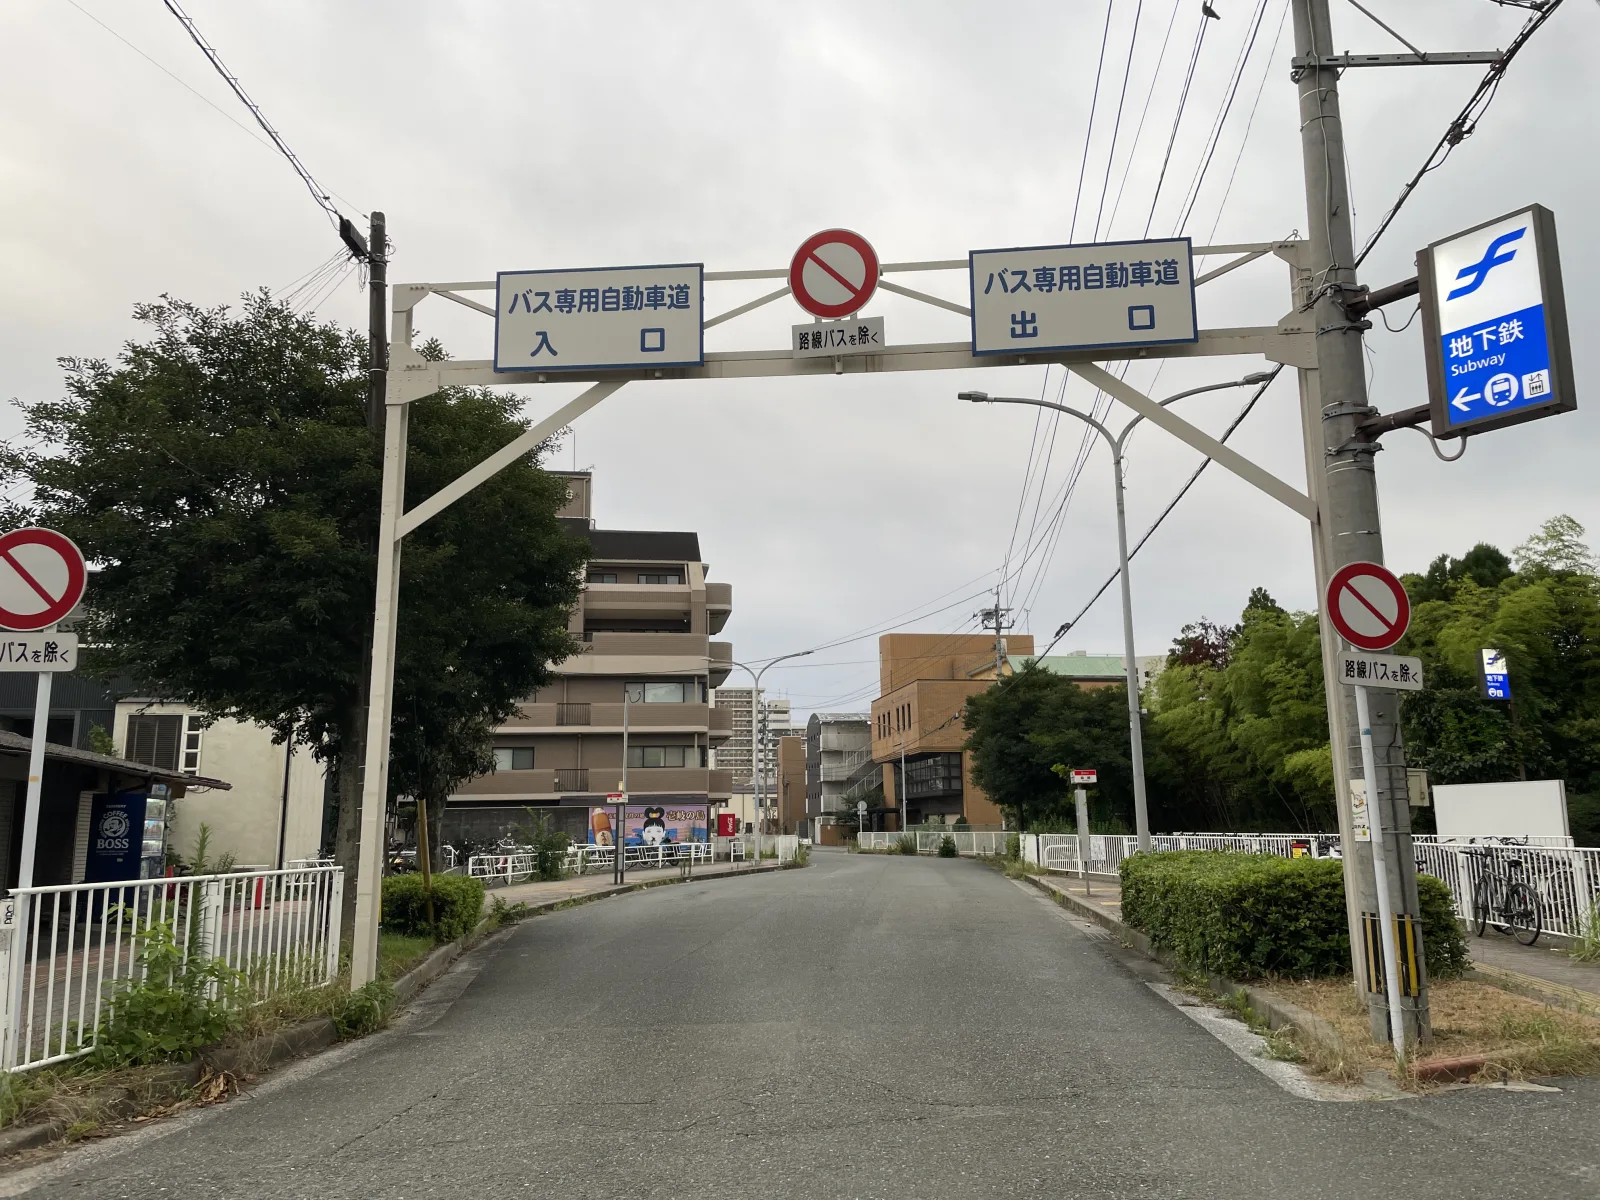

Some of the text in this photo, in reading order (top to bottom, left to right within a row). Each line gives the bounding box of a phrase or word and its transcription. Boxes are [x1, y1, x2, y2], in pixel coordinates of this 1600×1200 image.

[984, 259, 1180, 295] バス専用自動車道
[508, 283, 691, 315] バス専用自動車道
[798, 325, 879, 351] 路線バスを除く
[1448, 318, 1524, 358] 地下鉄
[1450, 352, 1506, 377] Subway
[0, 640, 69, 663] バスを除く
[1345, 659, 1419, 684] 路線バスを除く
[103, 810, 129, 820] COFFEE
[96, 838, 130, 849] BOSS
